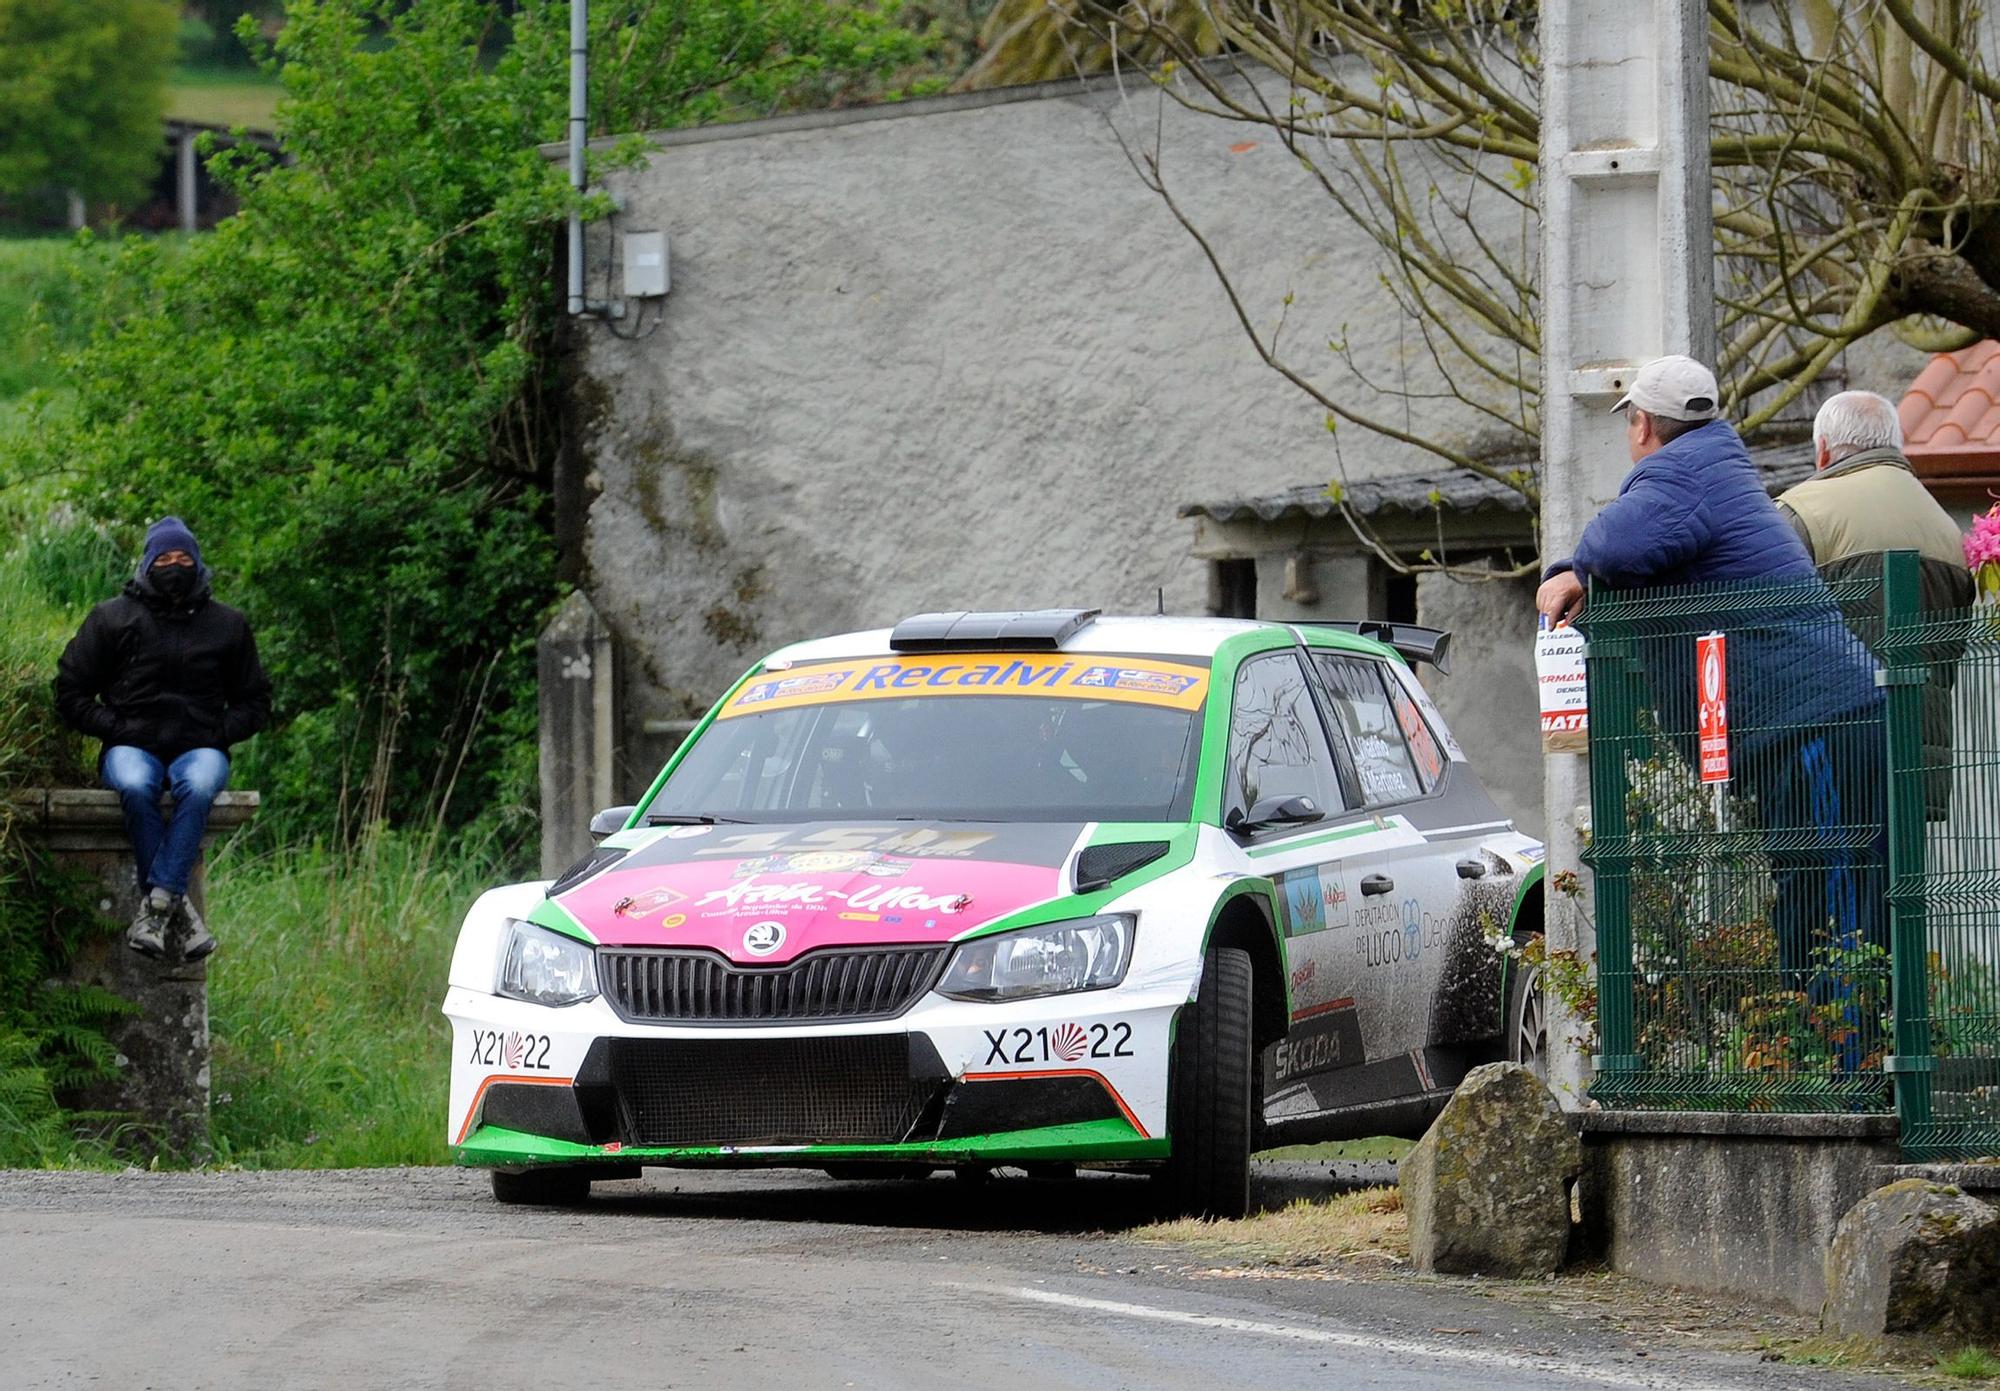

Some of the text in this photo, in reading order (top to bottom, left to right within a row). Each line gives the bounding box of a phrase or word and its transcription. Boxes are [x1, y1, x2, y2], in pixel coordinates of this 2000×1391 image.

[851, 661, 1075, 691] Recalvi
[1355, 900, 1400, 928] DEPUTACIÓN
[1367, 929, 1402, 968] LUGO
